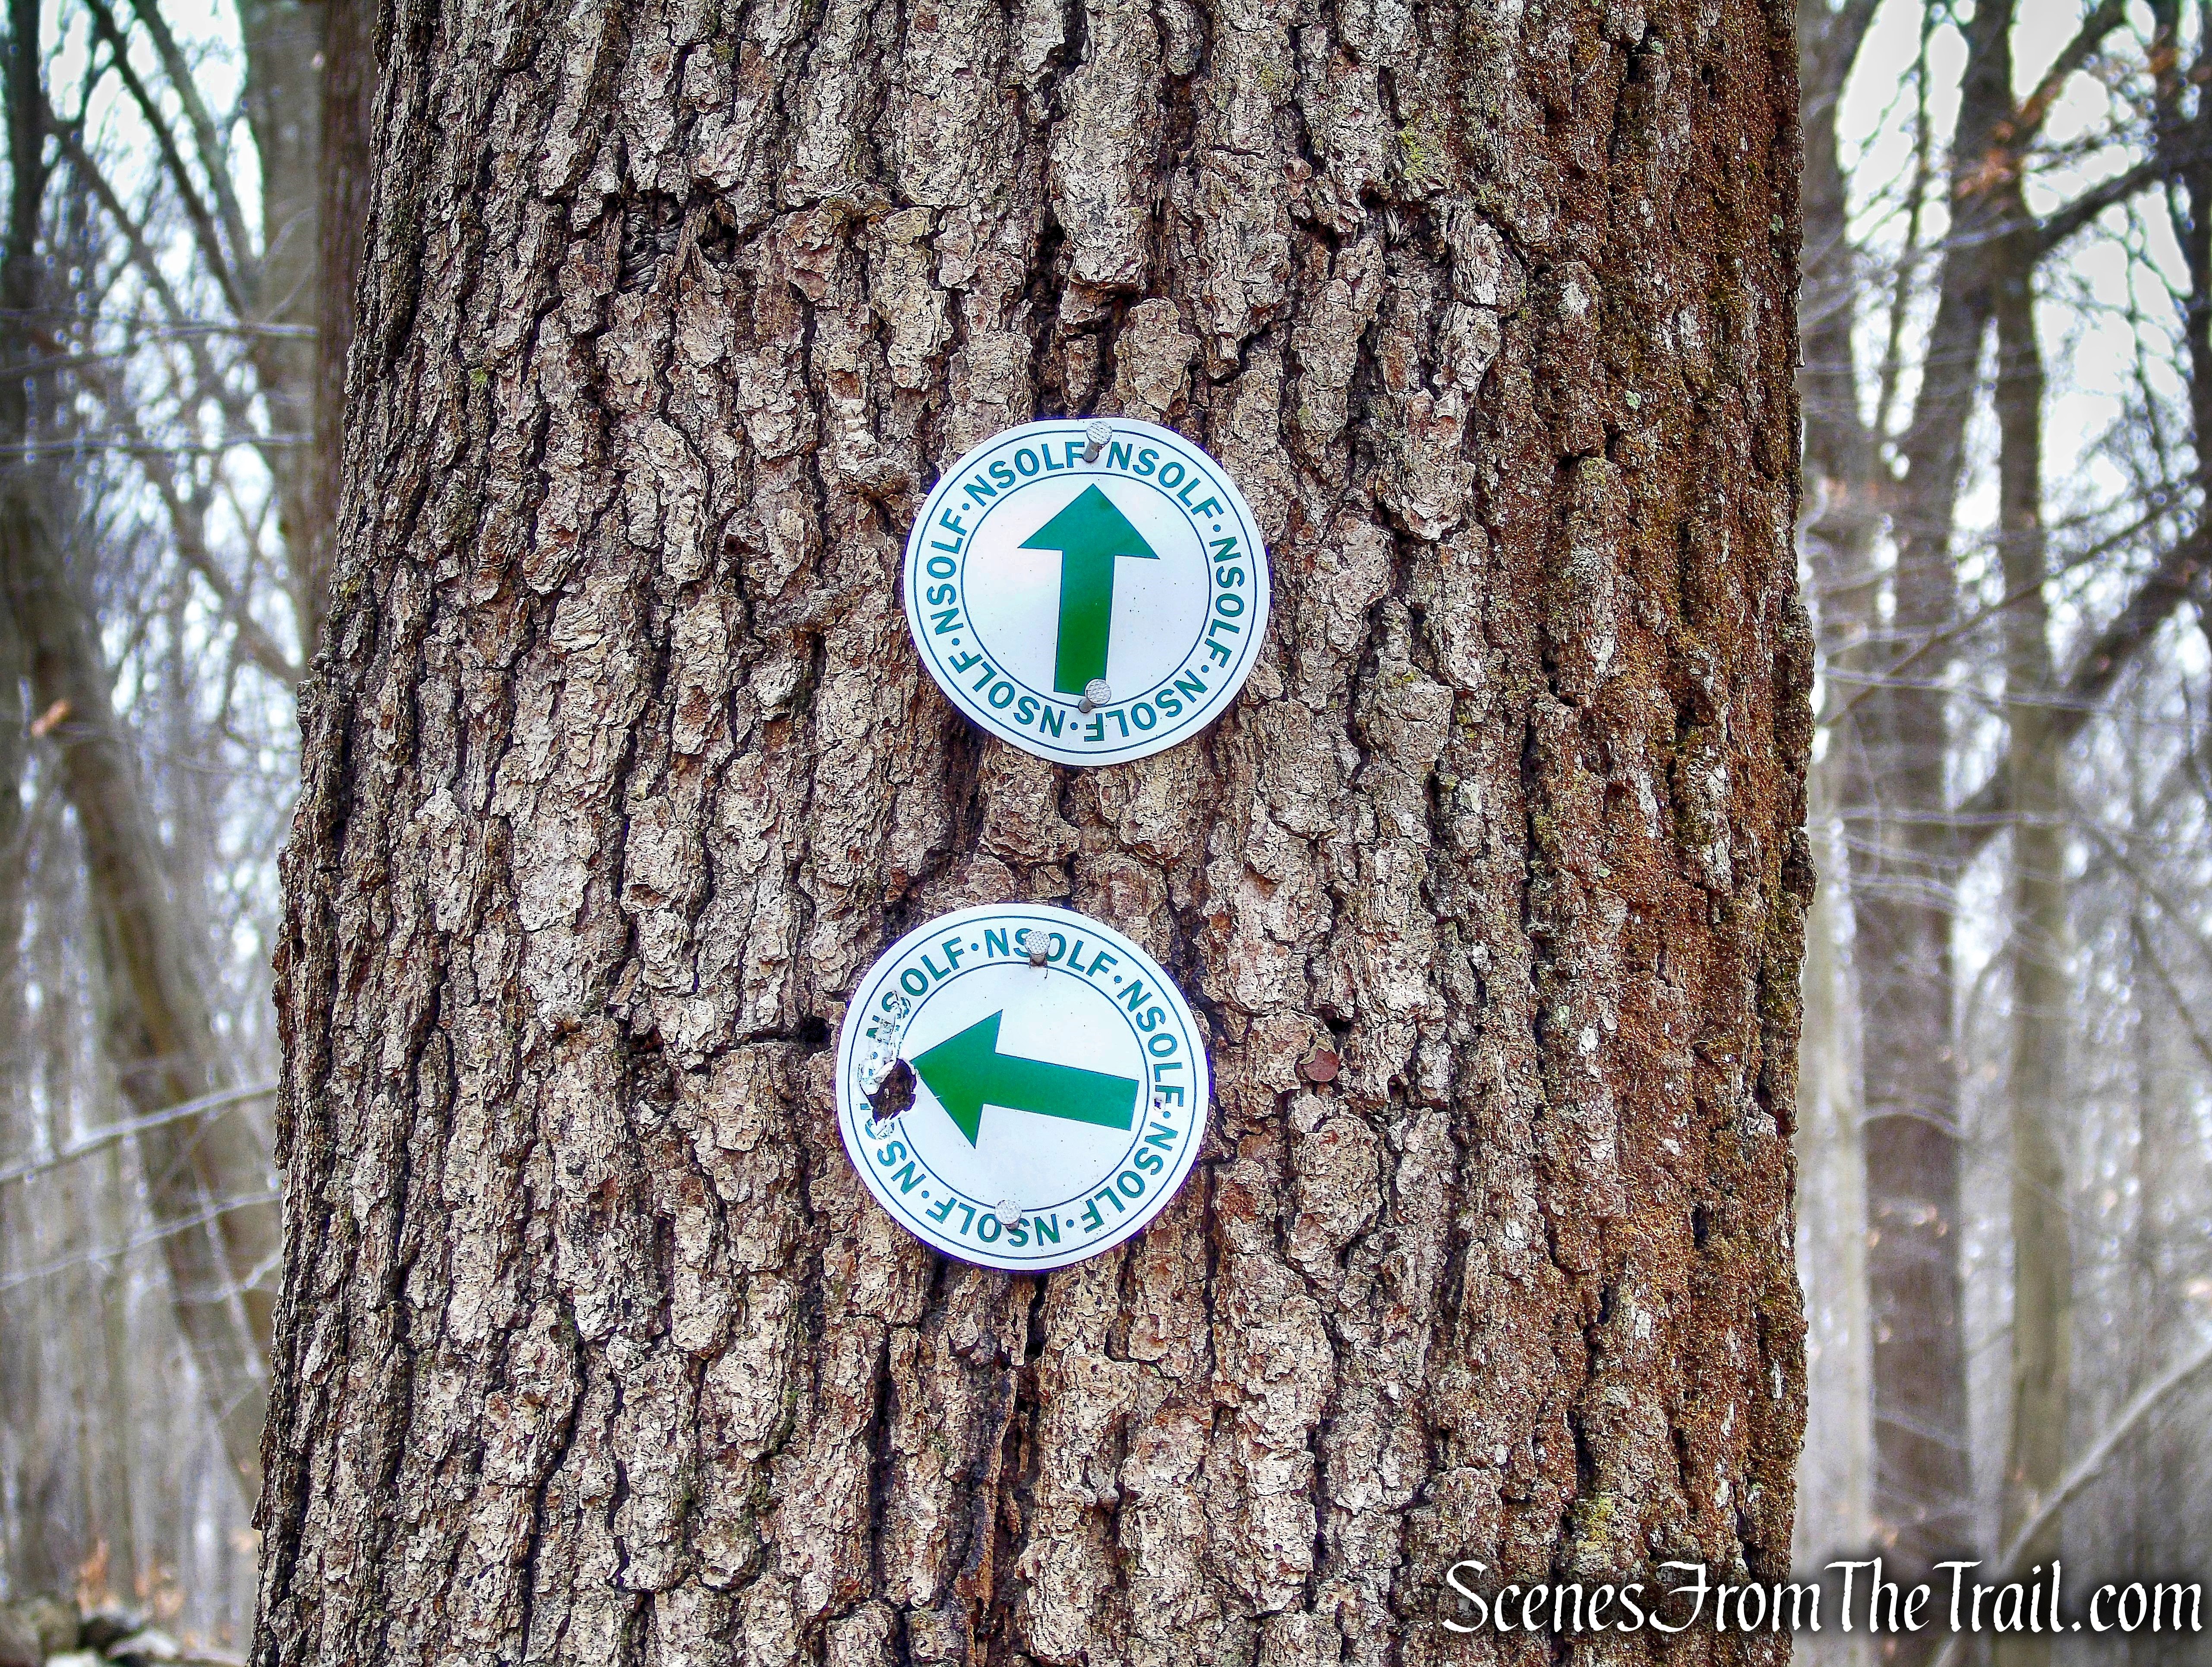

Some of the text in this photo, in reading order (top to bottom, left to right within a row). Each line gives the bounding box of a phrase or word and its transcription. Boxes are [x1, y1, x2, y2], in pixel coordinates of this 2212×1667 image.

[926, 441, 1245, 742] NSOLF NSOLF NSOLF NSOLF NSOLF NSOLF
[984, 928, 1118, 977] NSOLF
[1117, 980, 1184, 1106] NSOLF
[926, 1197, 1060, 1247] NSOLF
[1082, 1122, 1178, 1232] NSOLF
